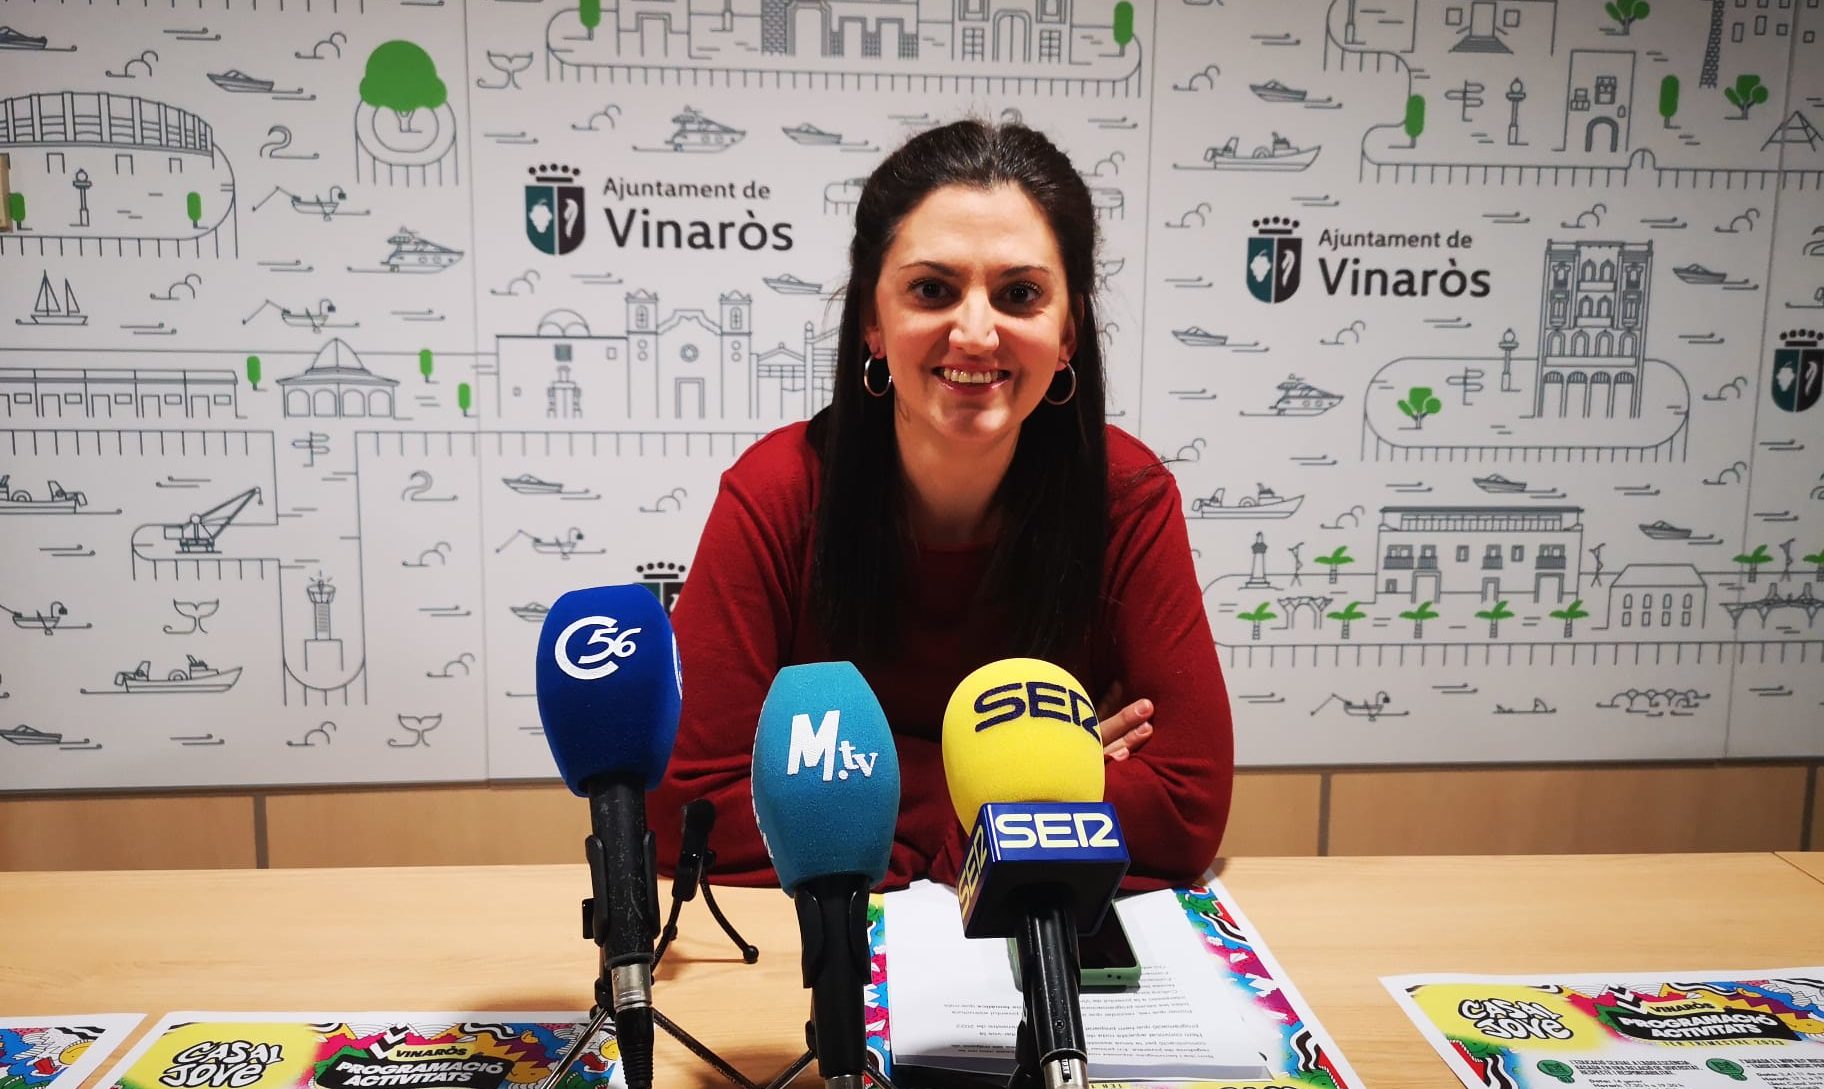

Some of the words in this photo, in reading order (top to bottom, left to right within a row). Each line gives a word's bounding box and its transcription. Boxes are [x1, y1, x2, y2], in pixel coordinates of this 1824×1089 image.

[603, 177, 736, 201] Ajuntament
[743, 180, 771, 199] de
[604, 208, 793, 251] Vinaròs
[1318, 229, 1440, 251] Ajuntament
[1446, 230, 1473, 248] de
[1318, 257, 1491, 298] Vinaròs
[974, 682, 1101, 742] SER
[995, 813, 1119, 848] SER
[960, 825, 987, 919] SER
[1458, 998, 1563, 1020] CASAL
[1650, 1001, 1715, 1013] VINARÒS
[1618, 1014, 1778, 1029] PROGRAMACIÓ
[1651, 1024, 1763, 1039] ACTIVITATS
[172, 1040, 284, 1064] CASAL
[396, 1046, 468, 1058] VINARÒS
[336, 1061, 503, 1075] PROGRAMACIÓ
[343, 1072, 474, 1087] ACTIVITATS
